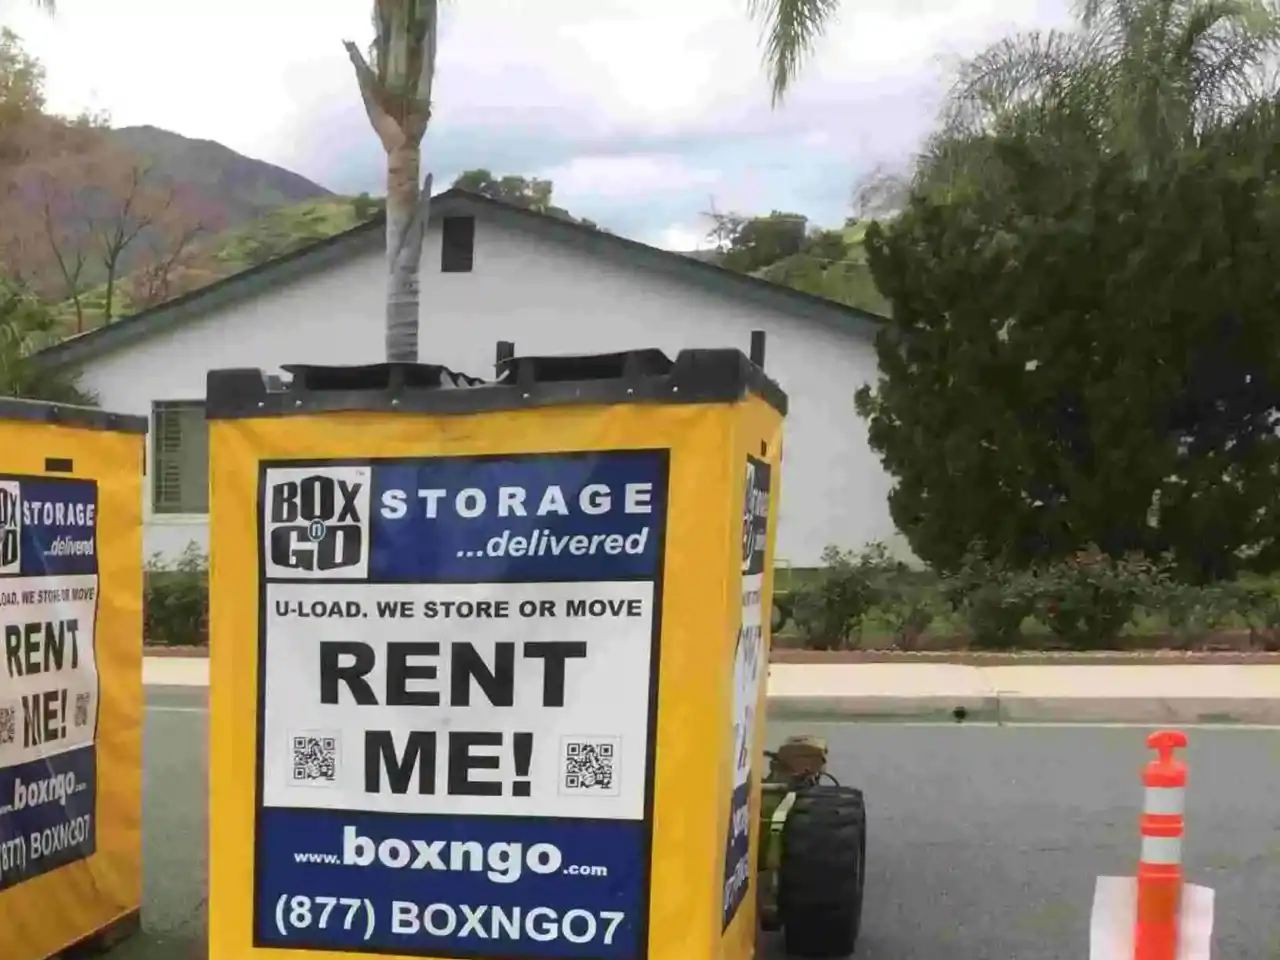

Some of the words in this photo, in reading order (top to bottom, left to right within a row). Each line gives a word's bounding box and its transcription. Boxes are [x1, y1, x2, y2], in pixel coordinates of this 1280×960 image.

[23, 501, 95, 527] STORAGE
[272, 474, 362, 523] BOX
[380, 483, 652, 520] STORAGE
[271, 524, 363, 572] GO
[456, 528, 648, 559] ...delivered
[22, 590, 36, 604] WE
[72, 587, 94, 601] MOVE
[276, 600, 368, 618] U-LOAD.
[377, 601, 414, 618] WE
[423, 601, 509, 618] STORE
[519, 600, 556, 618] OR
[566, 599, 642, 618] MOVE
[5, 619, 79, 678] RENT
[319, 641, 587, 708] RENT
[22, 689, 67, 748] ME!
[364, 730, 533, 798] ME!
[31, 815, 90, 860] BOXNGO7
[294, 825, 608, 883] www.boxngo.com
[275, 894, 375, 939] (877)
[391, 900, 625, 945] BOXNGO7
